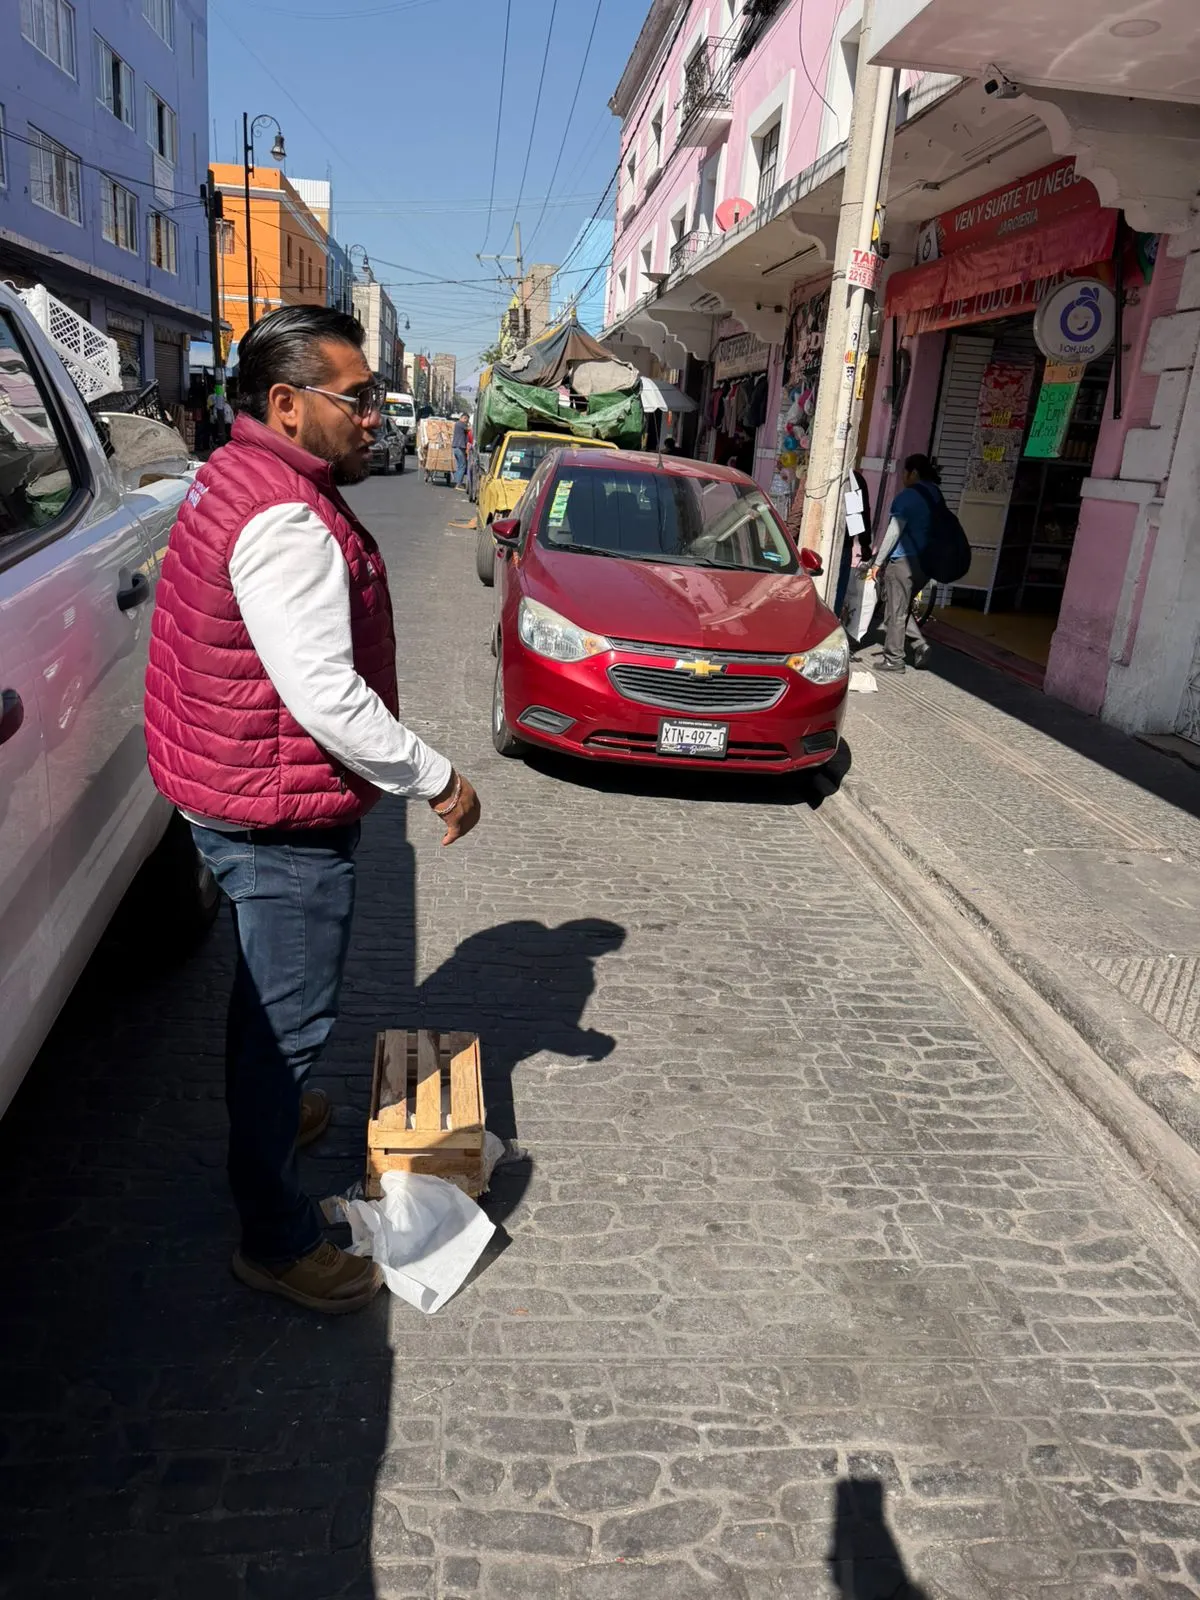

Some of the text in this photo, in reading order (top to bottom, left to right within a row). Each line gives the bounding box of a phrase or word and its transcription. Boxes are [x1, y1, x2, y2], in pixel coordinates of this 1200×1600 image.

[955, 210, 975, 232] VEN
[975, 204, 984, 223] Y
[984, 187, 1023, 220] SURTE
[1025, 178, 1044, 202] TU
[852, 249, 885, 272] TAROT
[950, 299, 968, 320] DE
